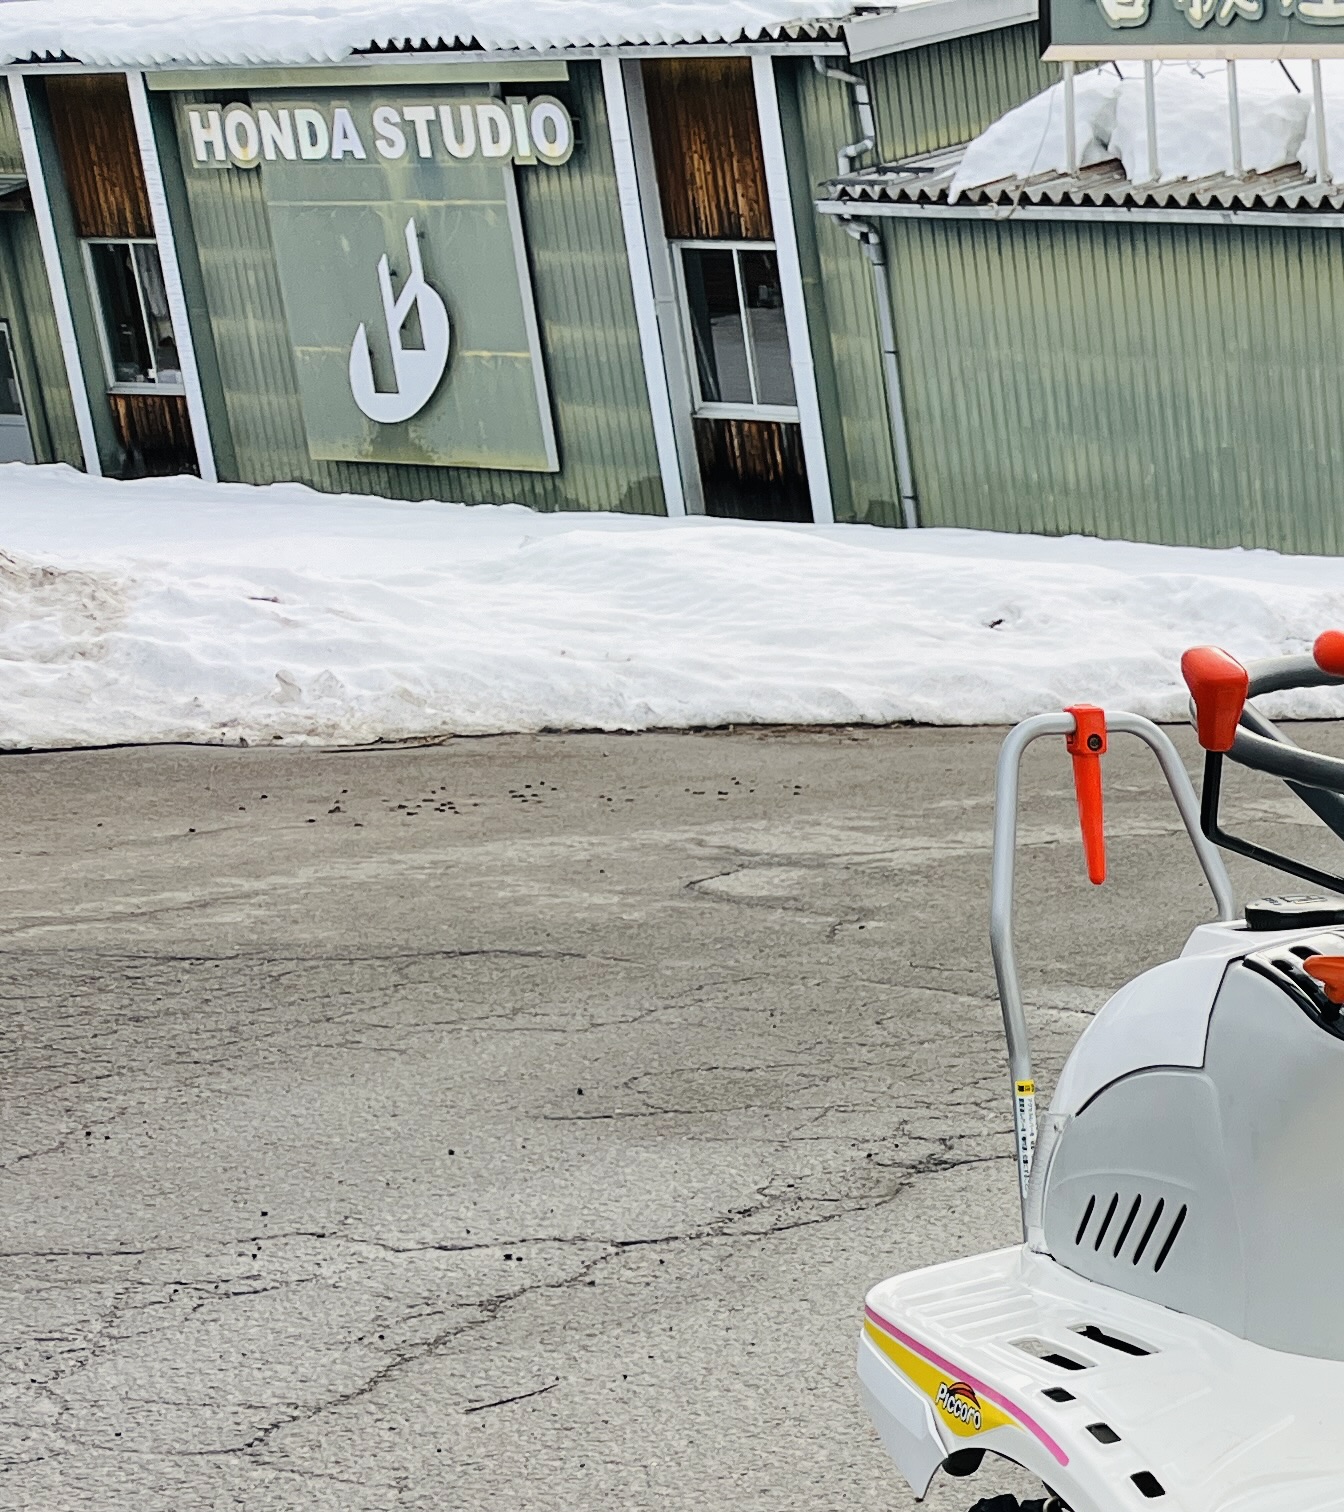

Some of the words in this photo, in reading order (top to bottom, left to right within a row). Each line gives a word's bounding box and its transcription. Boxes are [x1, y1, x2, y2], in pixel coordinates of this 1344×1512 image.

[188, 108, 367, 162] HONDA
[372, 102, 571, 161] STUDIO
[935, 1382, 982, 1430] Piccoro
